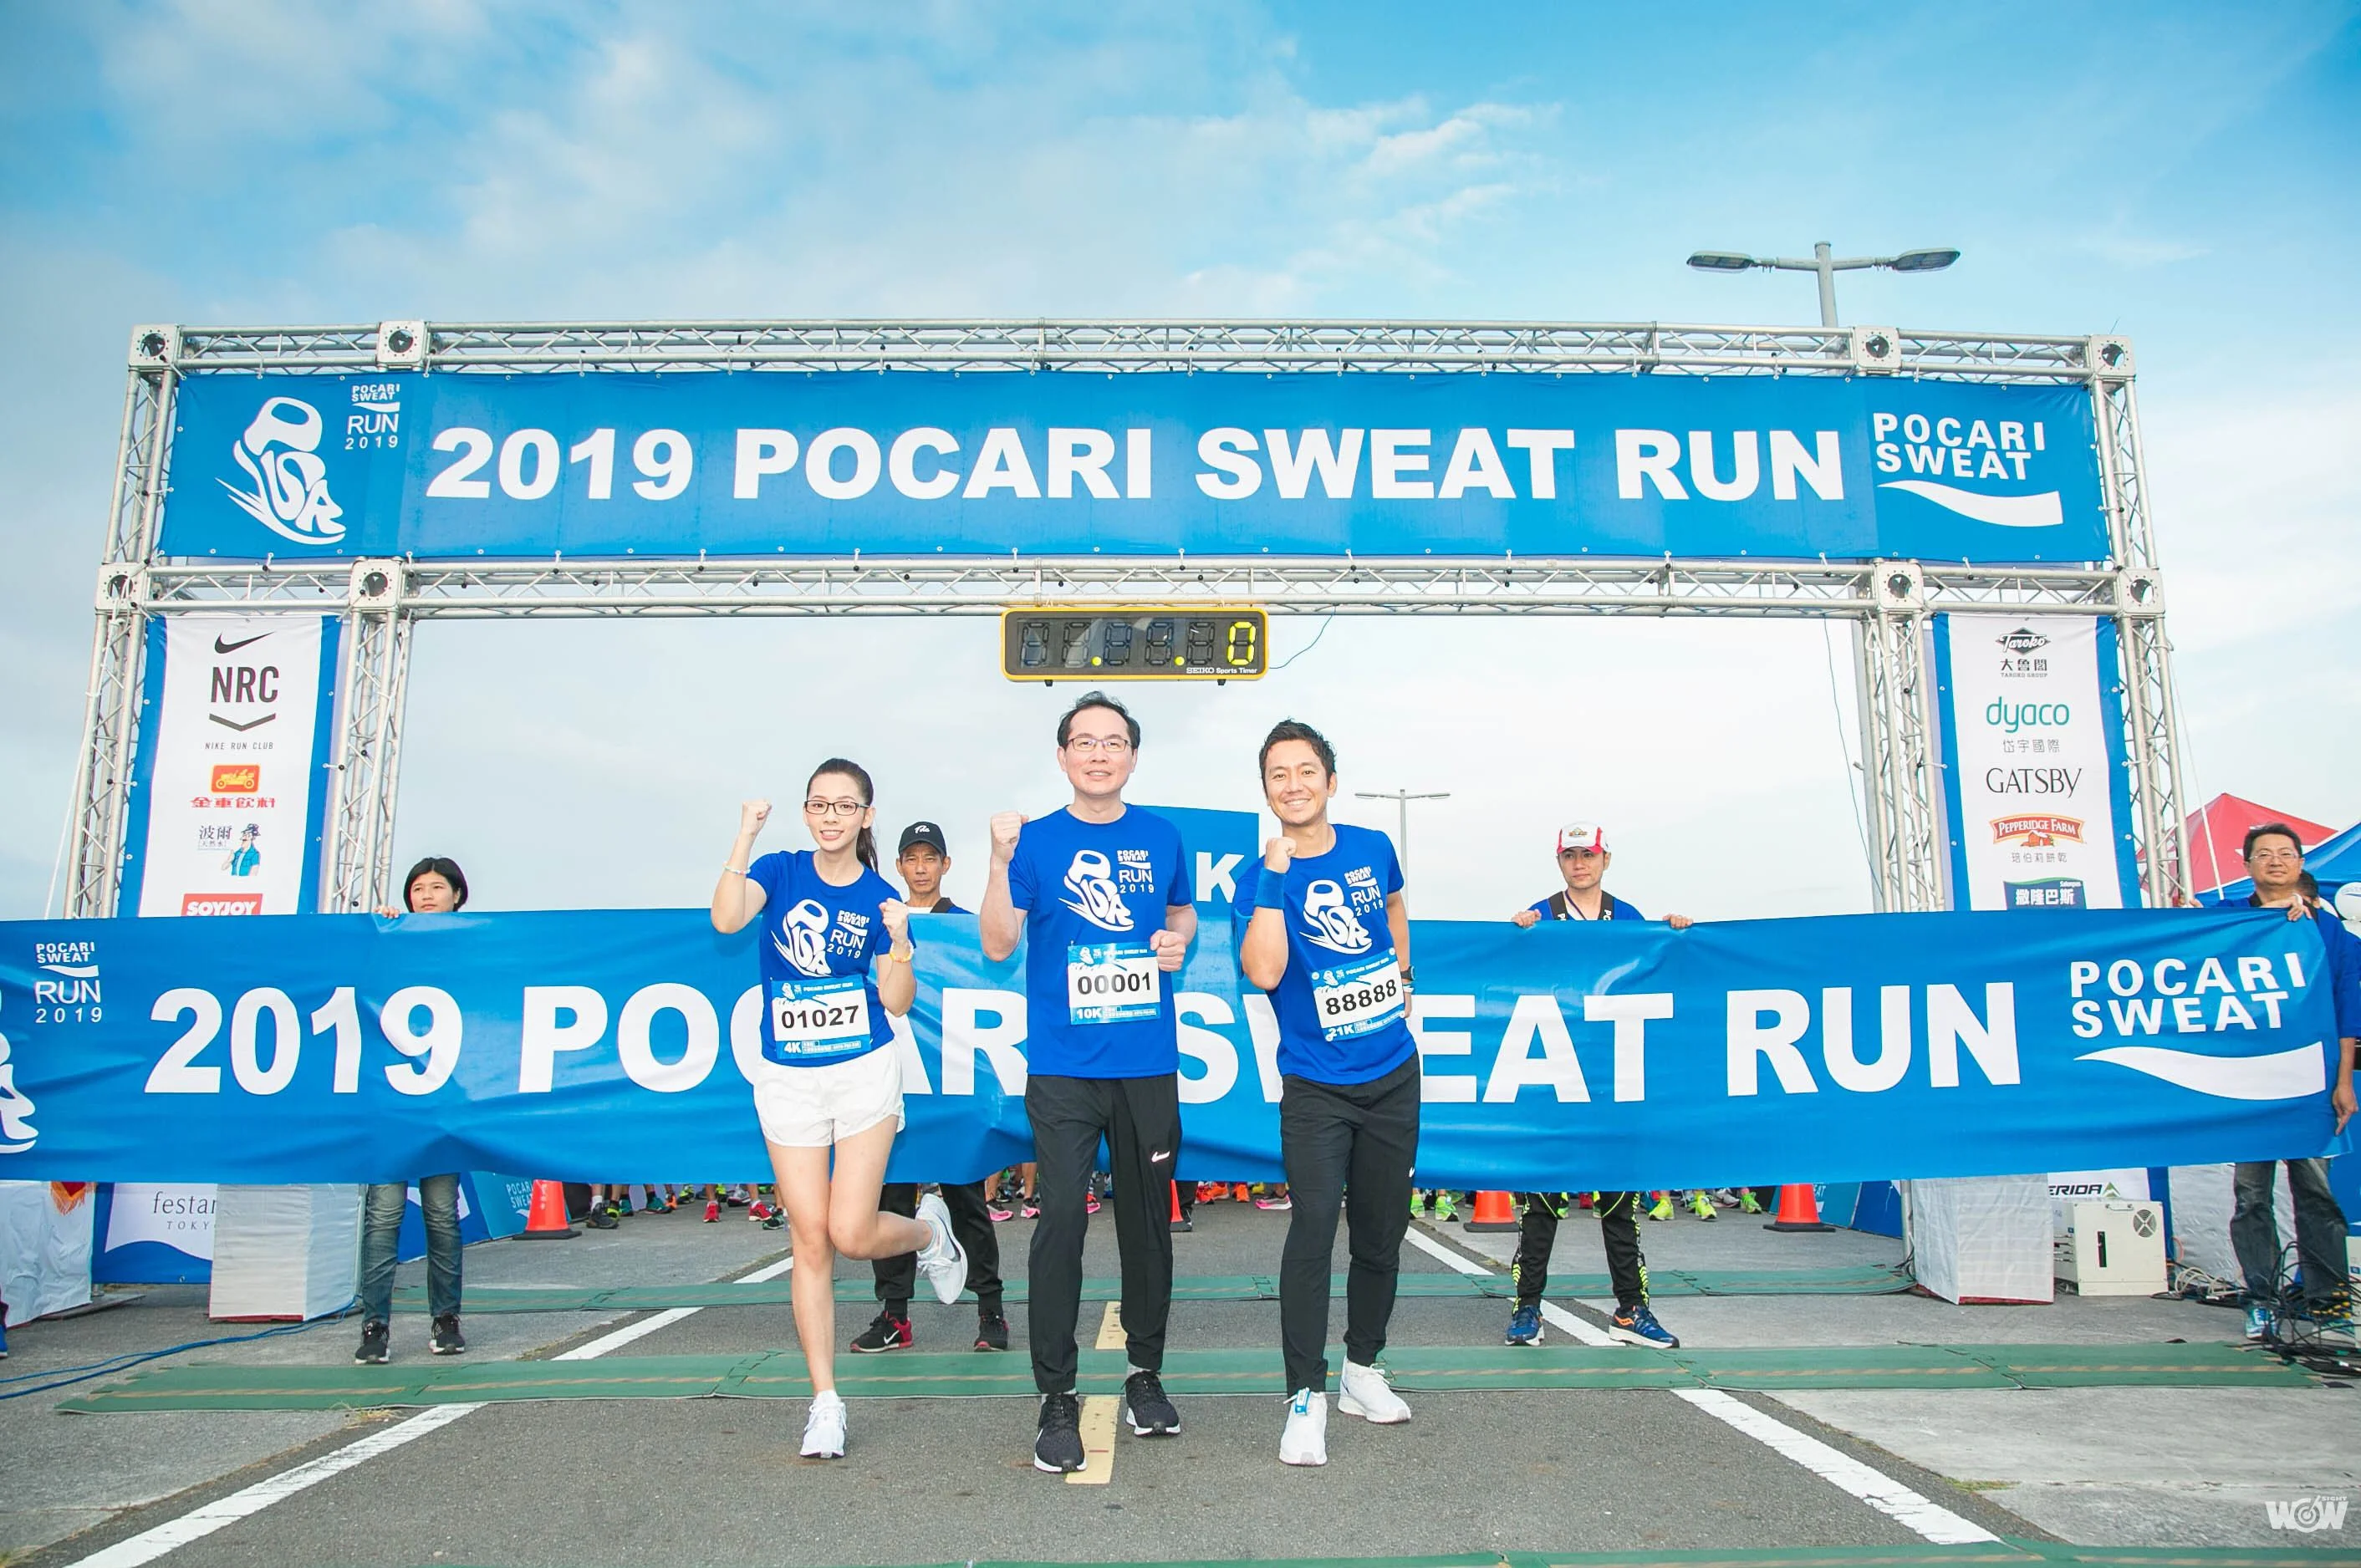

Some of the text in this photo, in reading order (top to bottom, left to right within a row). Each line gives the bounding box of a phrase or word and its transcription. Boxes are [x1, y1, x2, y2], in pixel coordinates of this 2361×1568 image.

[351, 392, 395, 402] SWEAT
[352, 384, 400, 394] POCARI
[347, 414, 400, 435] RUN
[1873, 412, 2046, 451] POCARI
[344, 435, 399, 450] 2019
[426, 427, 1844, 501] 2019 POCARI SWEAT RUN
[1876, 443, 2032, 481] SWEAT
[1998, 634, 2047, 653] Taroko
[210, 665, 279, 703] NRC
[1986, 695, 2070, 734] dyaco
[252, 741, 274, 750] CLUB
[1986, 767, 2083, 799] GATSBY
[190, 797, 276, 808] 金車飲料
[199, 825, 232, 840] 波爾
[1998, 818, 2076, 836] PEPPERIDGE FARM
[1119, 869, 1153, 883] RUN
[1119, 883, 1155, 893] 2019
[1351, 885, 1381, 906] RUN
[186, 901, 258, 916] SOYJOY
[1355, 899, 1384, 917] 2019
[36, 942, 95, 955] POCARI
[830, 929, 865, 950] RUN
[37, 951, 91, 964] SWEAT
[827, 944, 861, 959] 2019
[1077, 971, 1150, 995] 00001
[2070, 952, 2307, 998] POCARI
[34, 980, 101, 1004] RUN
[1325, 979, 1397, 1016] 88888
[35, 1007, 103, 1024] 2019
[781, 1005, 859, 1029] 01027
[1077, 1007, 1103, 1019] 10K
[2071, 990, 2289, 1038] SWEAT
[1328, 1024, 1355, 1037] 21K
[145, 982, 2021, 1105] 2019 POR SEAT RUN
[784, 1041, 802, 1053] 4K
[2048, 1184, 2102, 1196] ERIDA
[167, 1220, 216, 1229] TOKY
